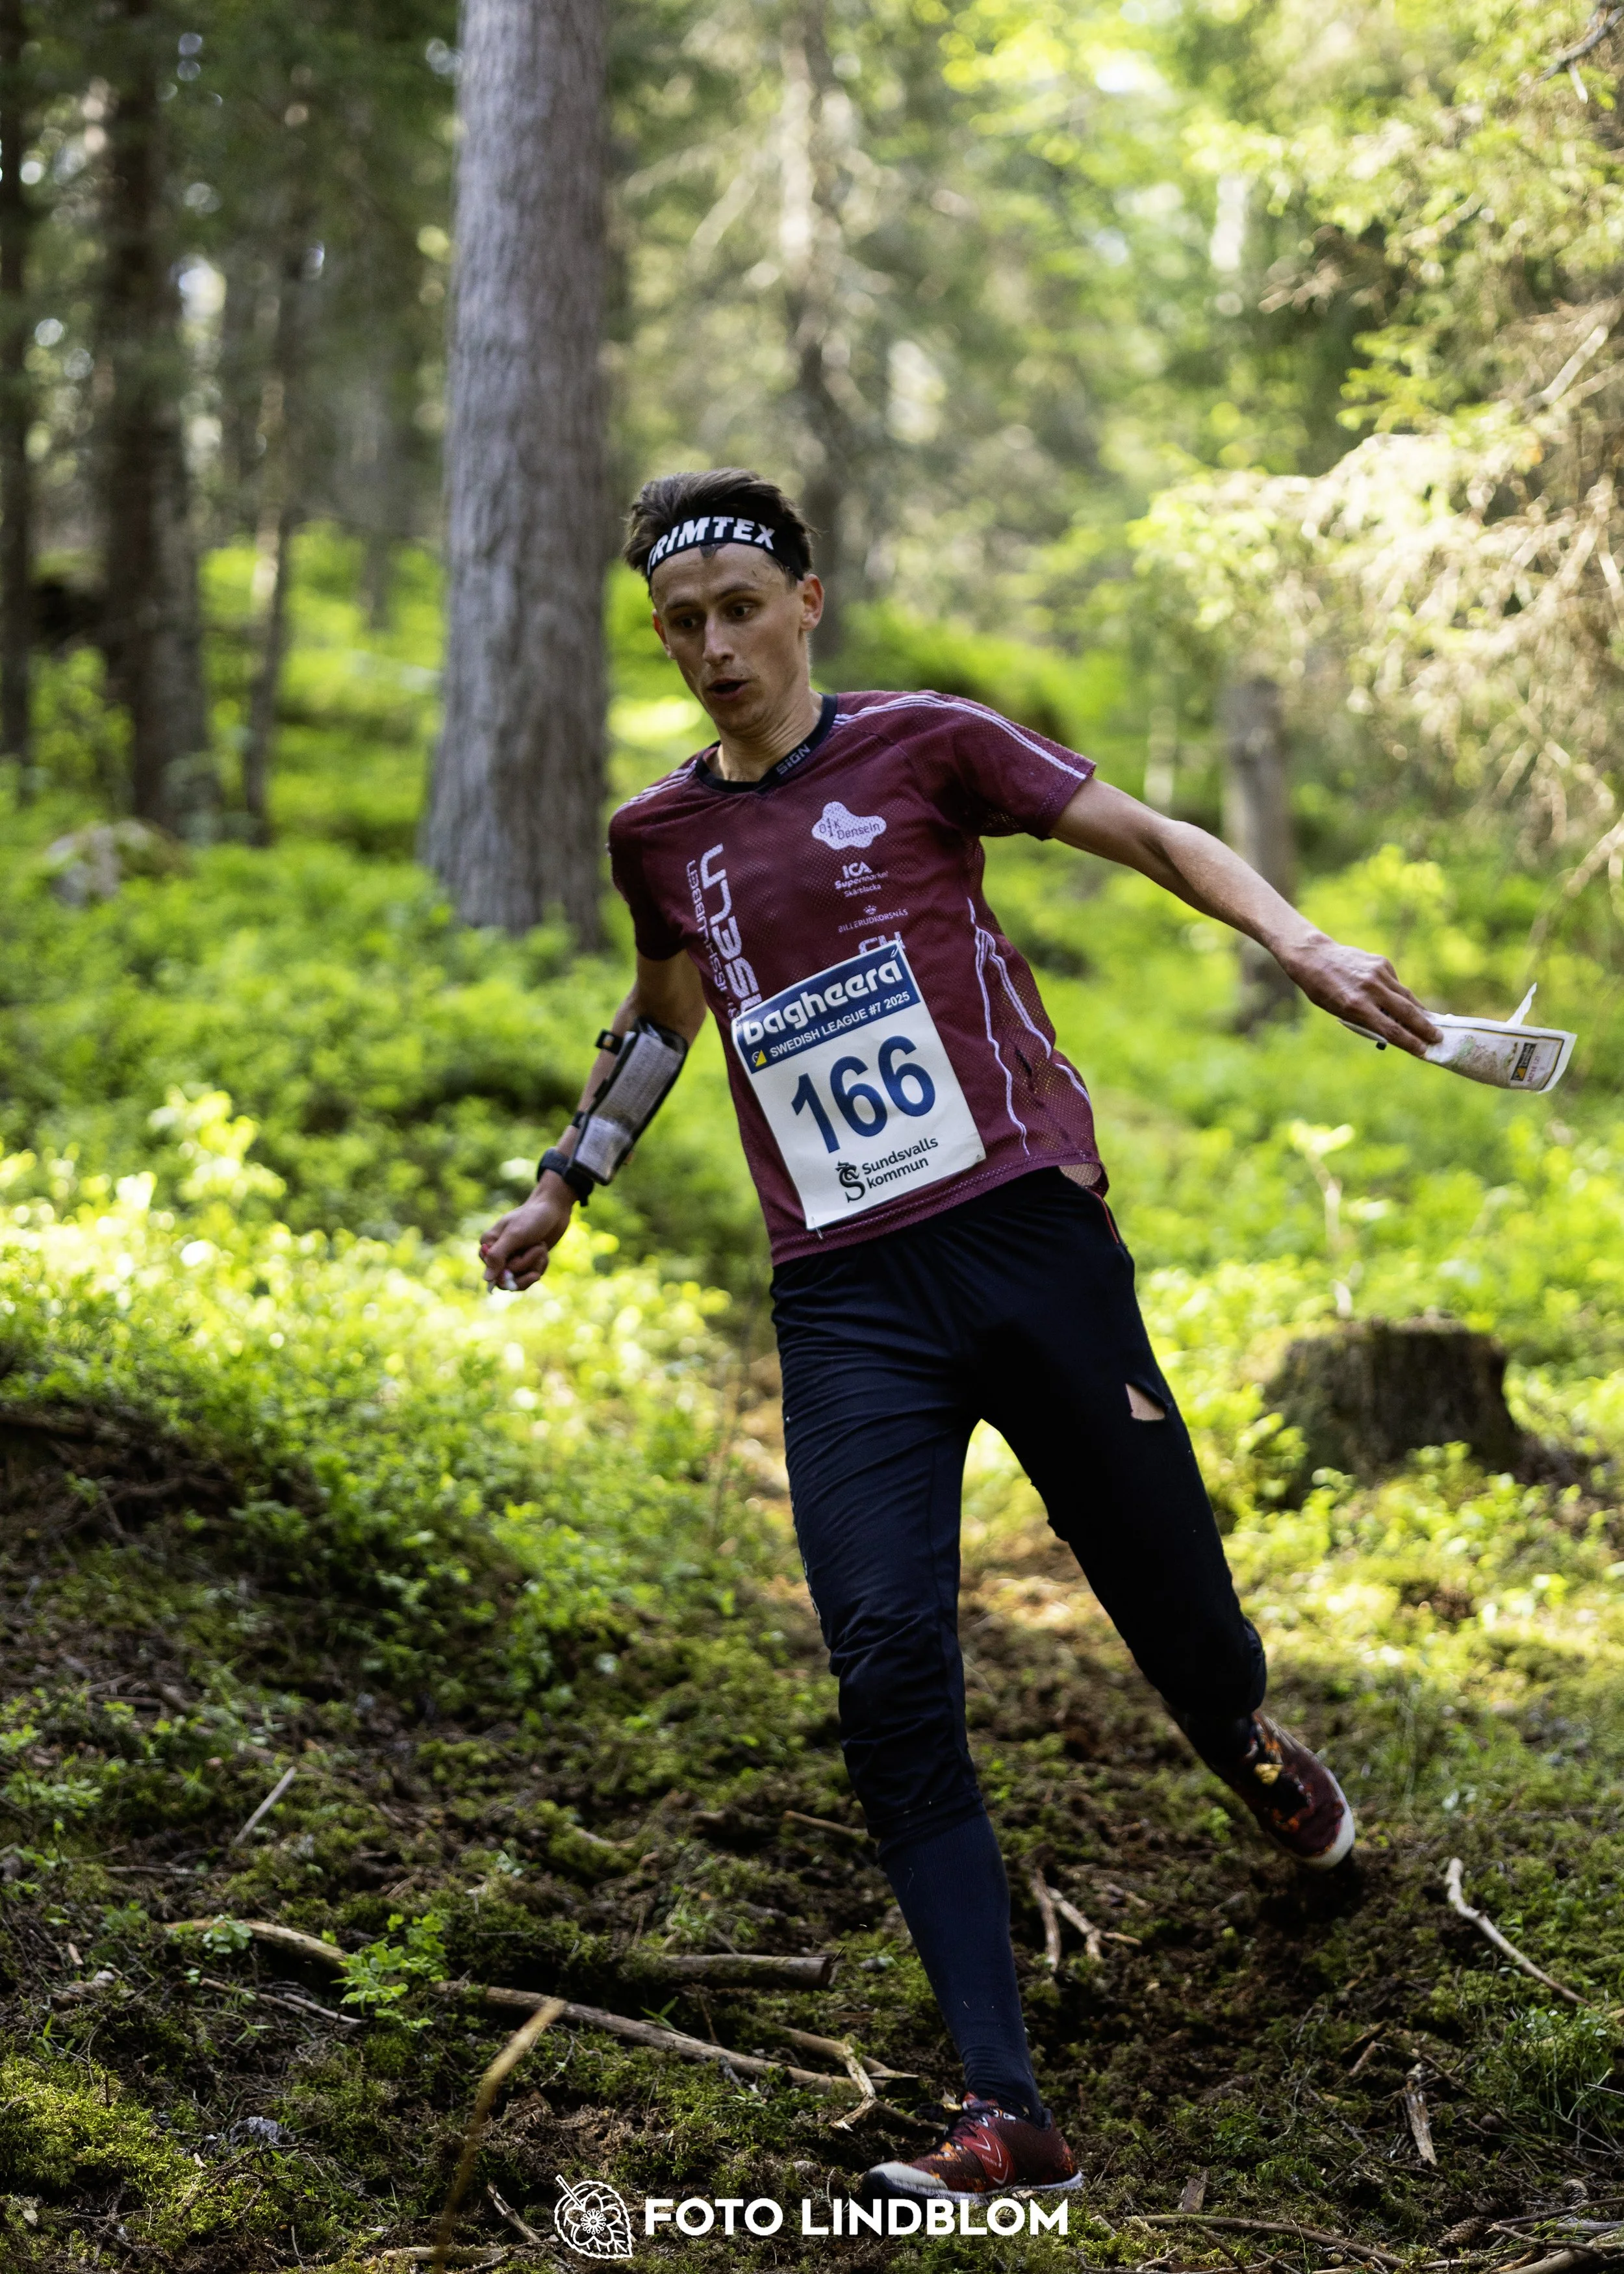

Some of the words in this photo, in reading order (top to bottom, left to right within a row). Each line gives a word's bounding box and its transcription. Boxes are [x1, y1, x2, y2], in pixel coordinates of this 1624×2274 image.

[842, 862, 872, 879] ICA
[742, 958, 903, 1045] bagheera
[770, 1028, 820, 1058] SWEDISH
[820, 1008, 869, 1036] LEAGUE
[869, 1002, 882, 1017] #7
[883, 991, 910, 1010] 2025
[791, 1036, 935, 1154] 166
[862, 1138, 939, 1175] Sundsvalls
[867, 1158, 929, 1189] kommun
